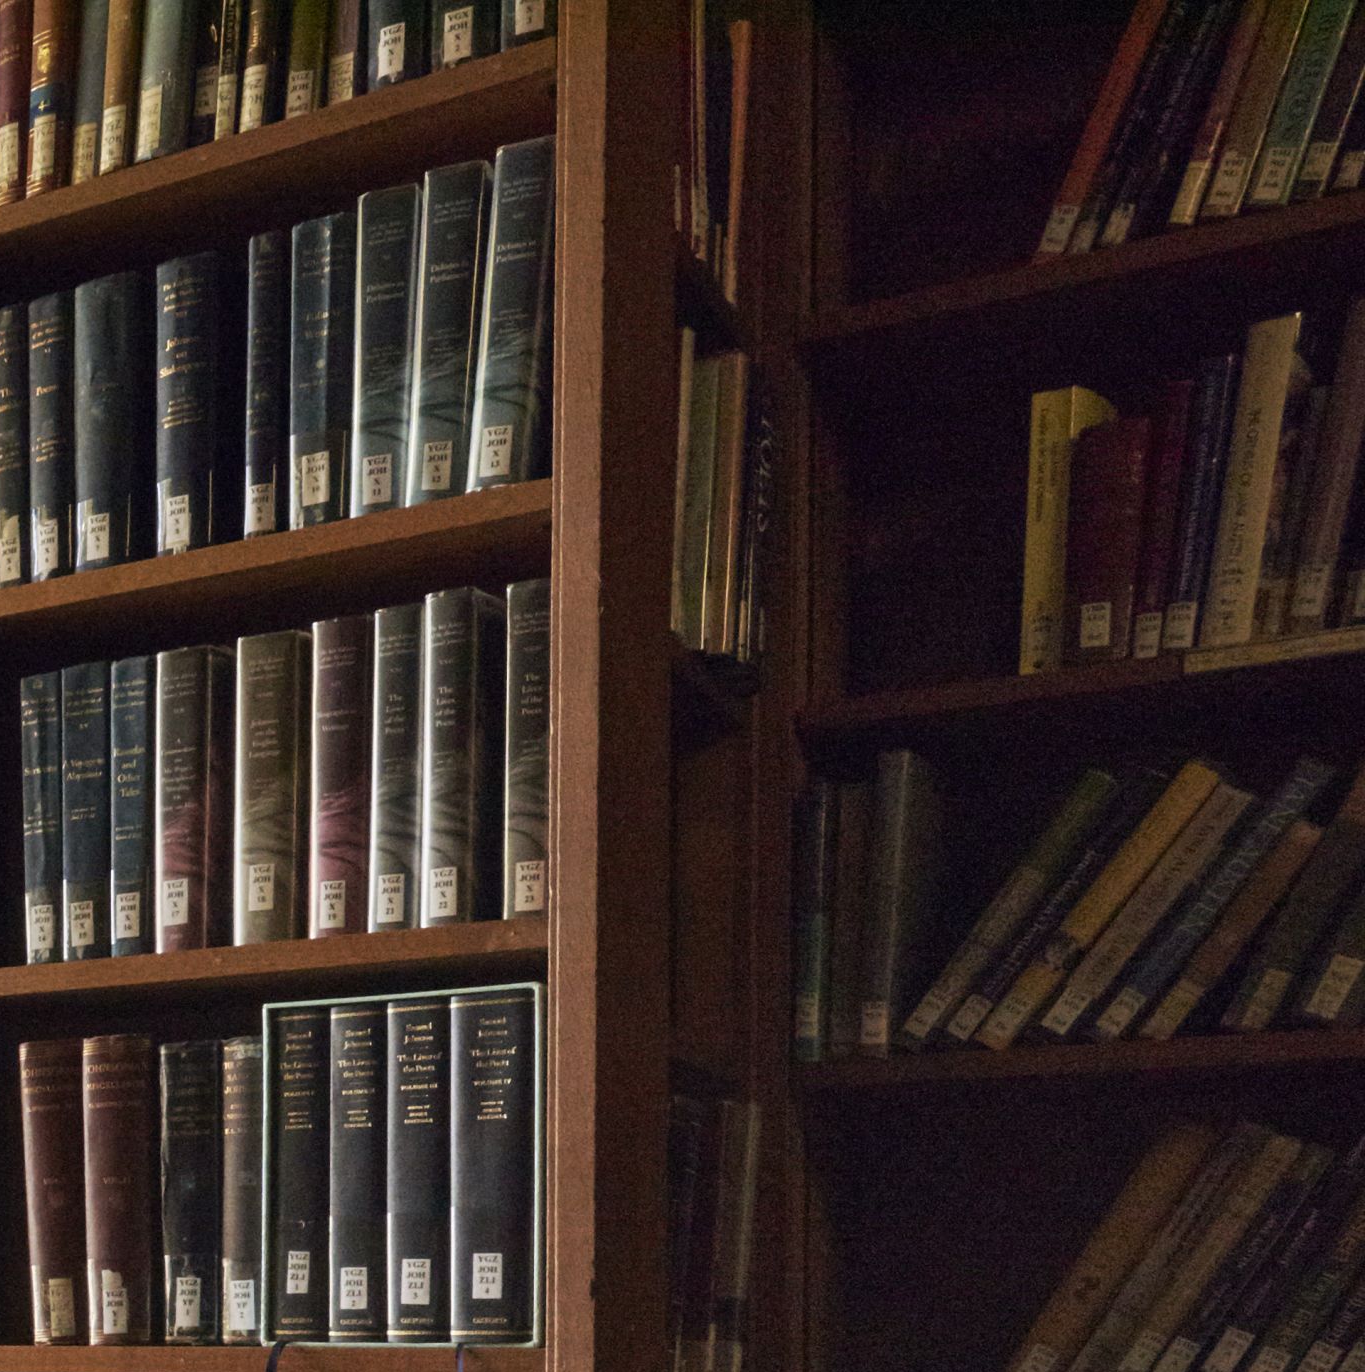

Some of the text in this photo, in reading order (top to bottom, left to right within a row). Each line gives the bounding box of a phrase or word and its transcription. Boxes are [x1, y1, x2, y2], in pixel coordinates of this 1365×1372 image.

[382, 25, 402, 36] YGZ
[448, 22, 469, 33] JOH
[383, 36, 401, 48] JOH
[488, 427, 509, 437] YGZ
[428, 443, 449, 452] YGZ
[486, 439, 507, 448] JOH
[367, 457, 388, 466] YGZ
[428, 454, 448, 463] JOH
[368, 467, 387, 476] JOH
[253, 866, 271, 875] YGZ
[520, 863, 540, 871] YGZ
[433, 869, 454, 878] YGZ
[519, 874, 540, 882] JOH
[253, 876, 271, 884] JOH
[381, 876, 401, 884] YGZ
[324, 883, 343, 891] YGZ
[381, 886, 400, 894] JOH
[324, 893, 343, 901] JOH
